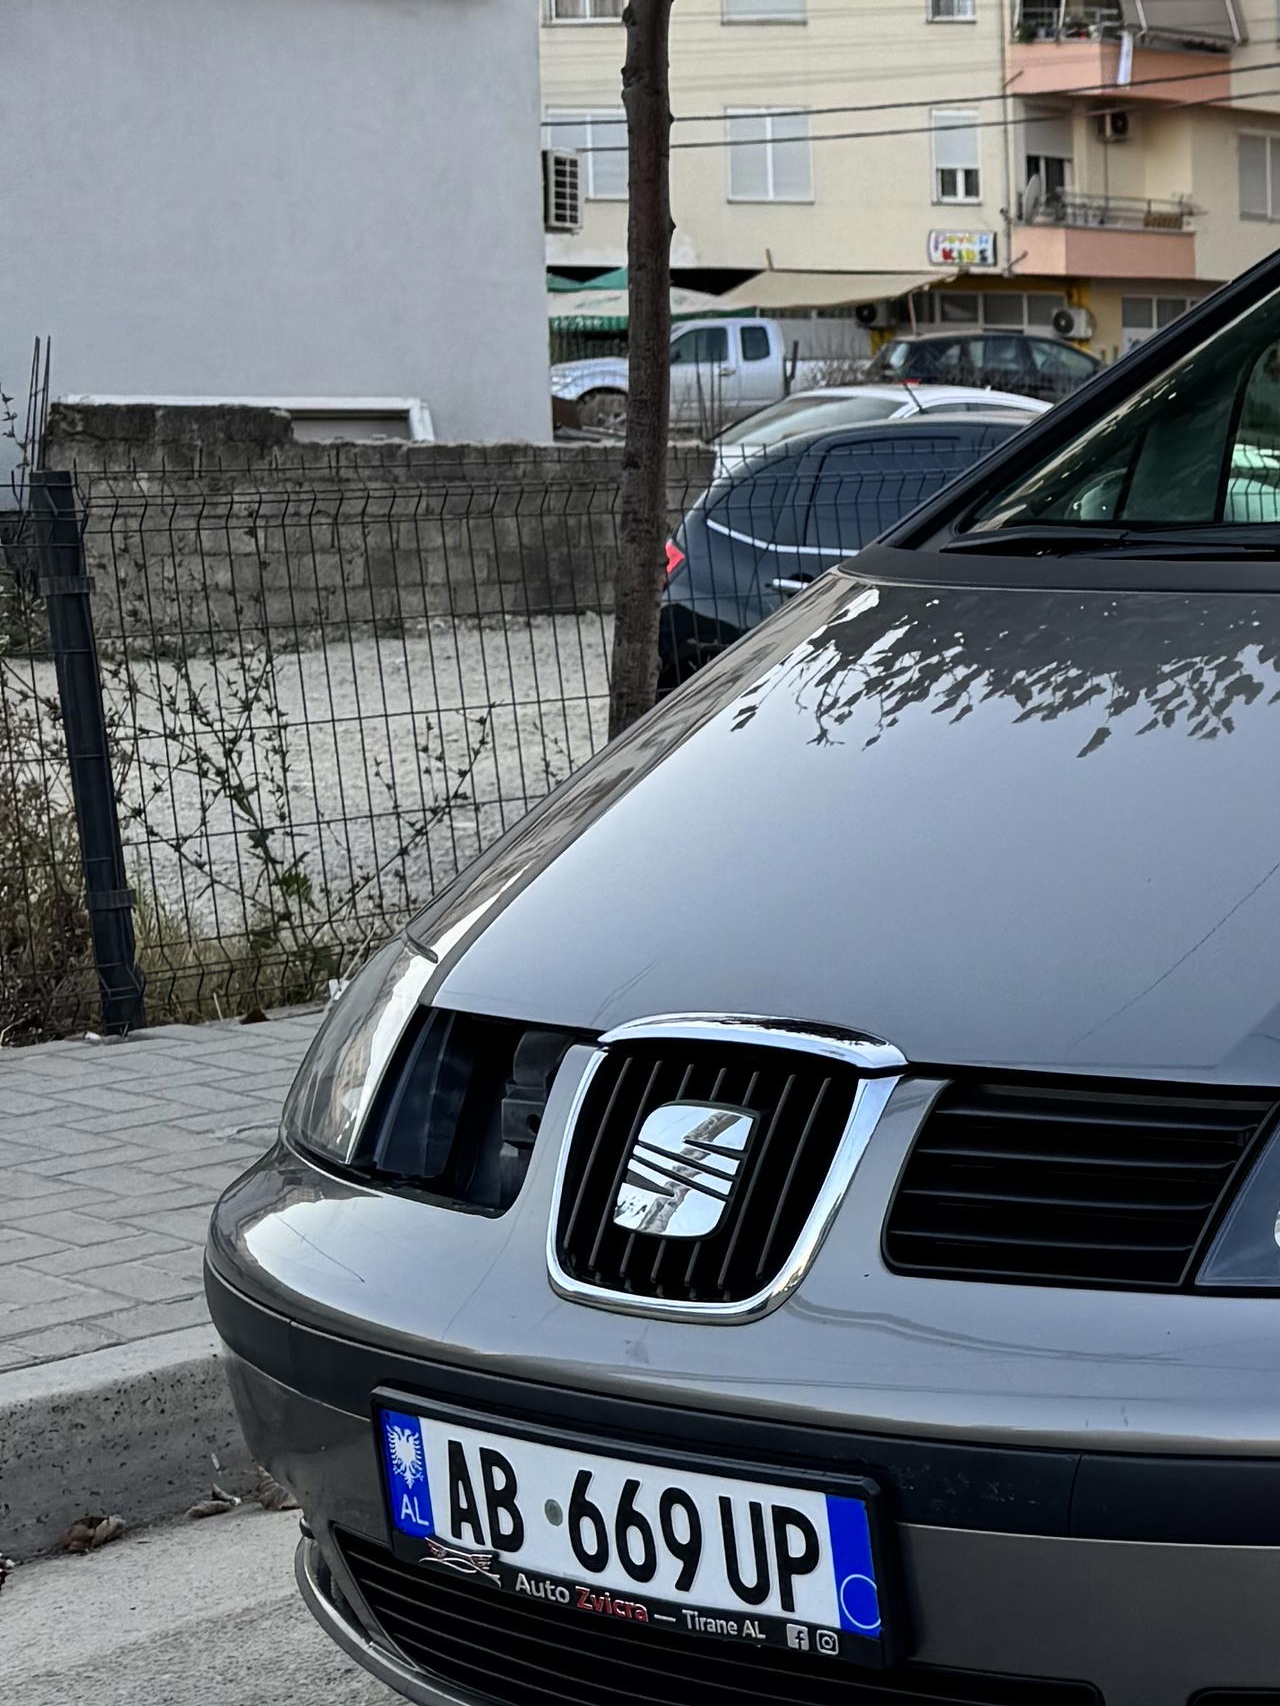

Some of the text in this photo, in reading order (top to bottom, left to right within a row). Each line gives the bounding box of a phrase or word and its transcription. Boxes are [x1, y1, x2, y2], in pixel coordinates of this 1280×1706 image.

[400, 1495, 430, 1527] AL
[447, 1439, 820, 1613] AB 669 UP
[515, 1572, 767, 1640] Auto Zvicra Tirane AL
